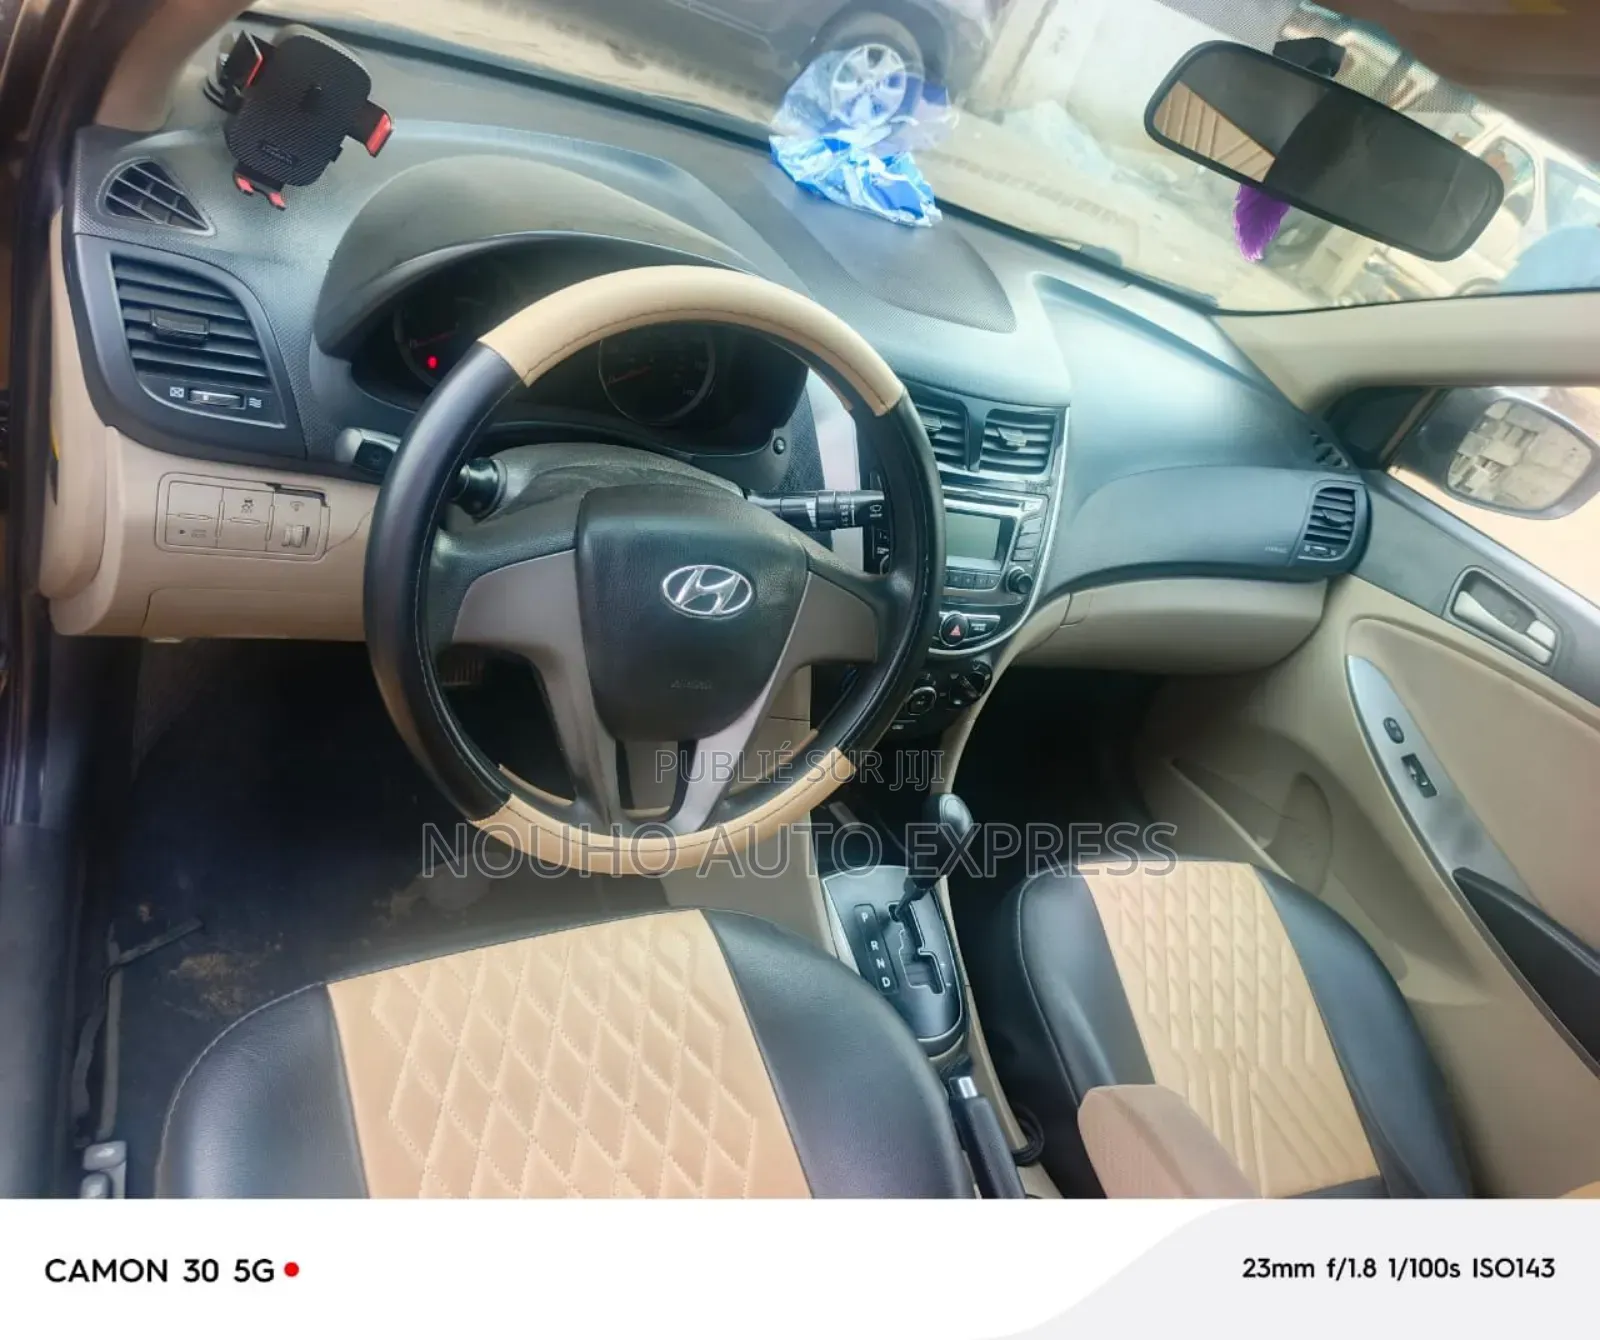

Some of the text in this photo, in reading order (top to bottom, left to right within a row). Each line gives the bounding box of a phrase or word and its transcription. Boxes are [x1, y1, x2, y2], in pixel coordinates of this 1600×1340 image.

[861, 911, 891, 988] P R N D
